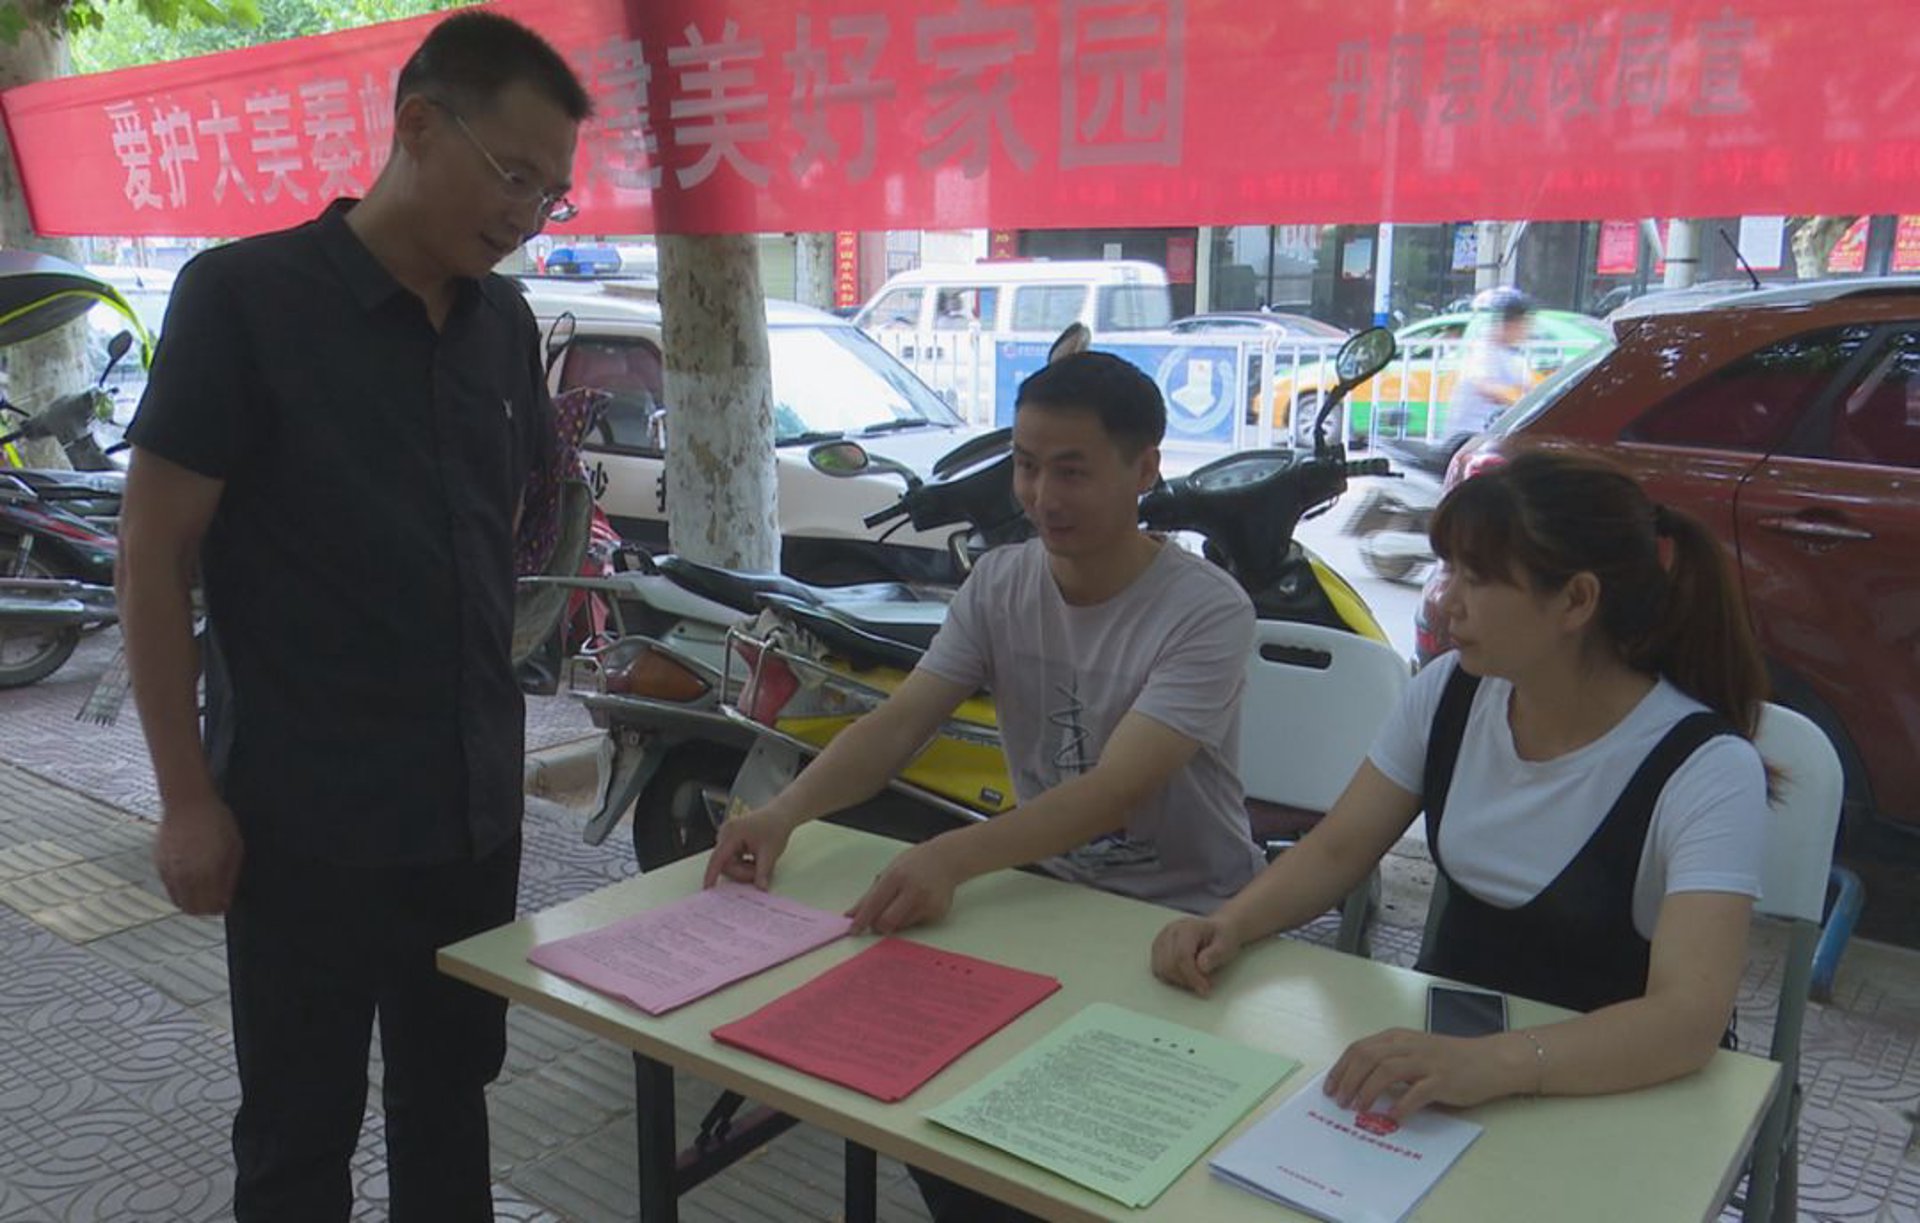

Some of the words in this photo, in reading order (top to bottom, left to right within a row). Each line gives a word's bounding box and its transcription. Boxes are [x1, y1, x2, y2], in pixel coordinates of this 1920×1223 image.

[1327, 6, 1757, 132] 丹凤县发改局宣
